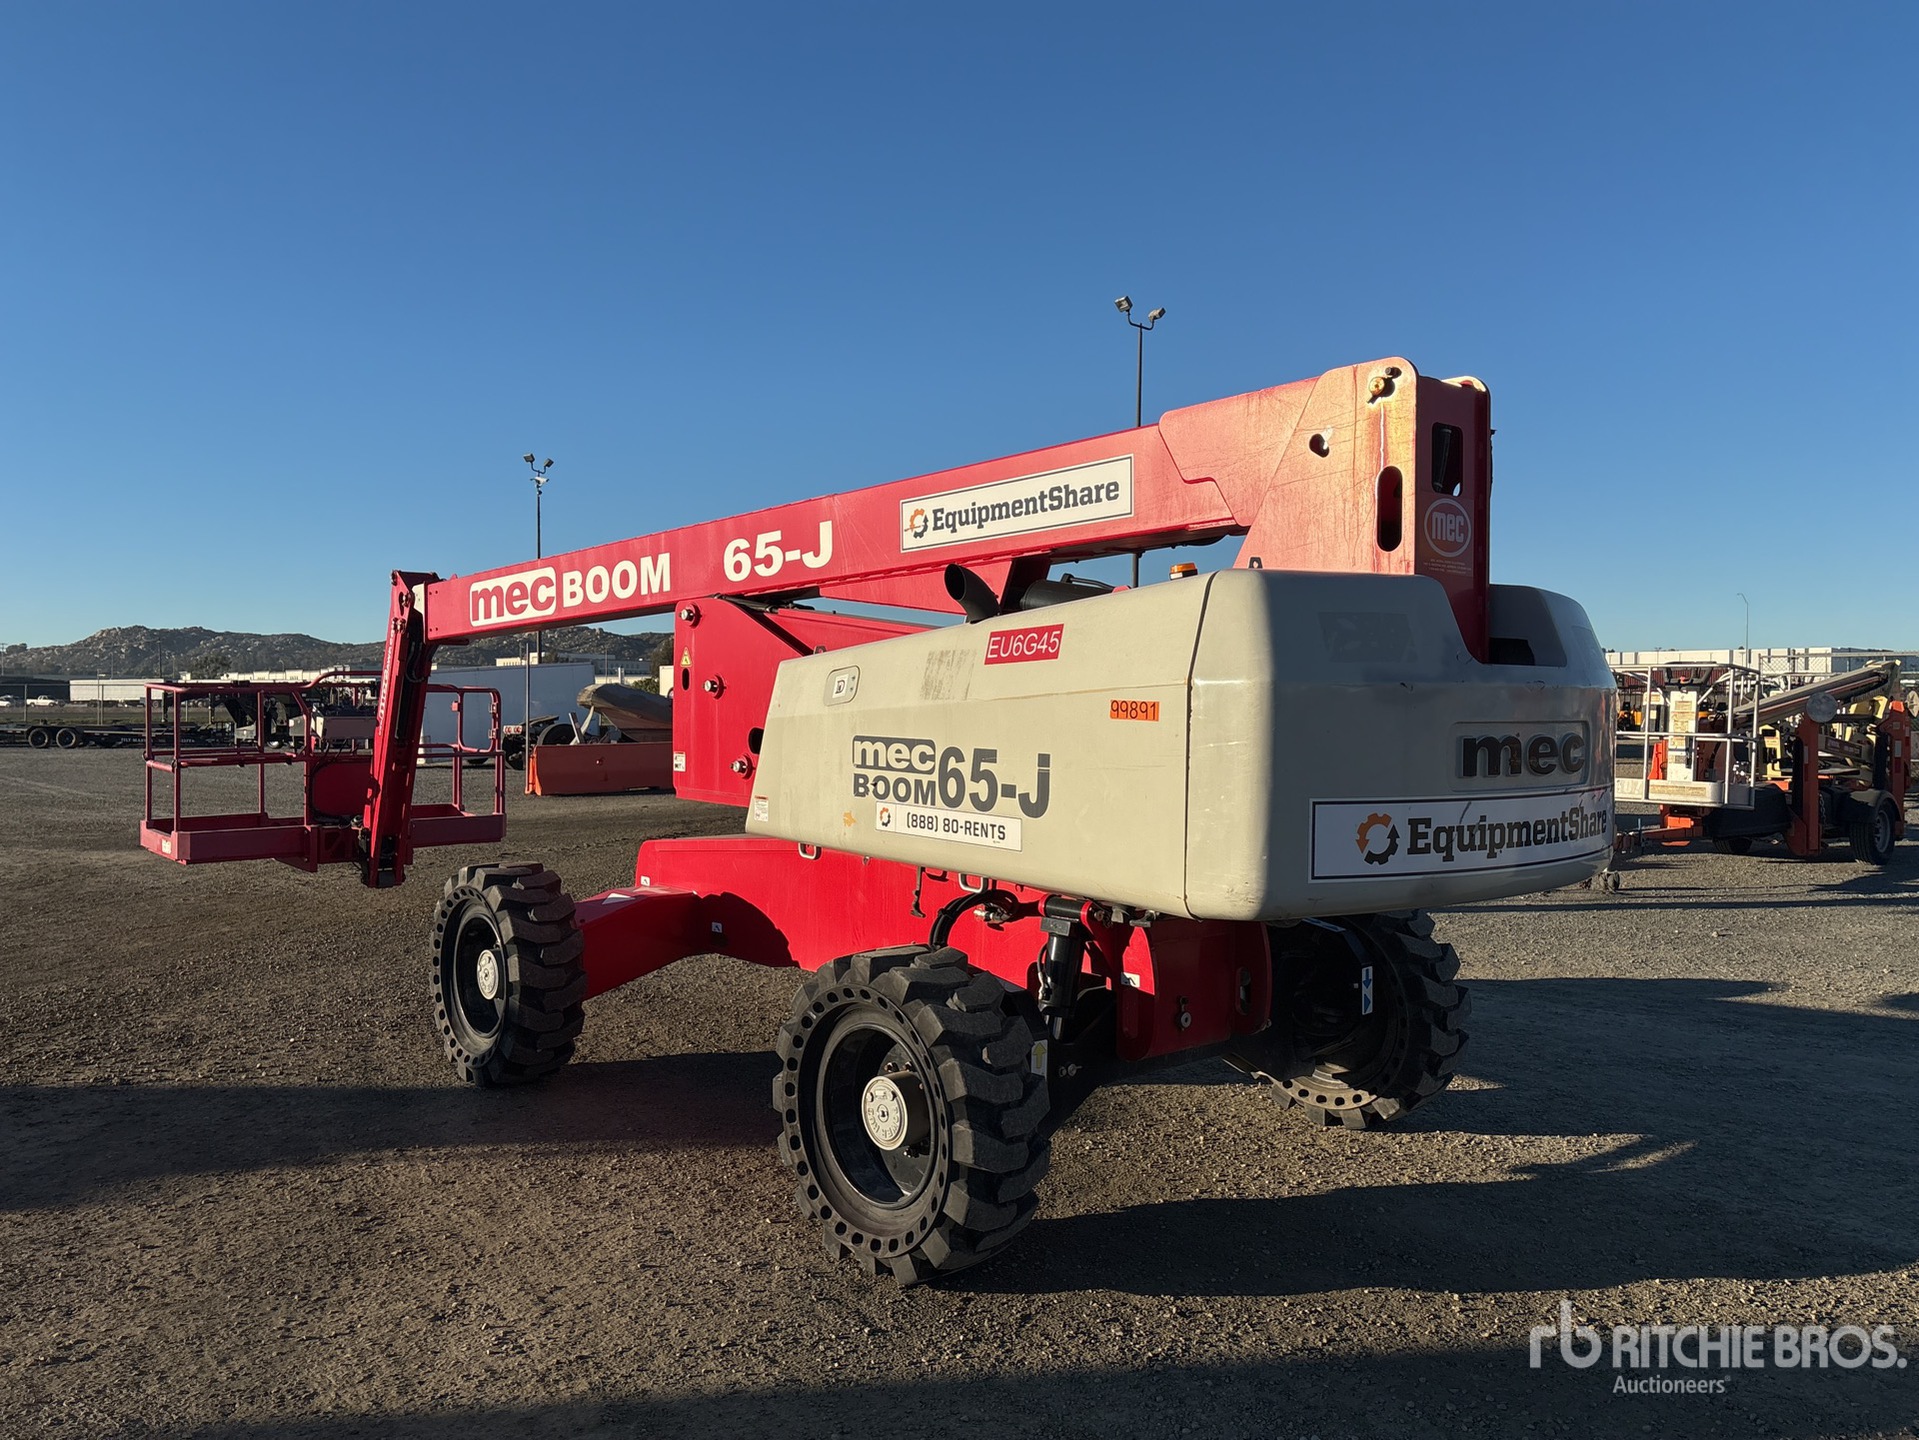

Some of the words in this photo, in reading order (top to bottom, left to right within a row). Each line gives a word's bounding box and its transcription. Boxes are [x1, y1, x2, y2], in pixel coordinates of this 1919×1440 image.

[931, 480, 1120, 534] EquipmentShare
[1431, 511, 1465, 543] mec
[723, 520, 833, 582] 65-J
[471, 575, 556, 622] mec
[562, 552, 671, 609] BOOM
[988, 629, 1061, 660] EU6G45
[1110, 700, 1157, 720] 99891
[853, 739, 935, 774] mec
[1461, 733, 1586, 777] mec
[853, 773, 936, 807] BOOM
[937, 746, 1052, 819] 65-J
[906, 811, 939, 833] (888)
[943, 817, 1006, 841] 80-RENTS
[1407, 804, 1609, 862] EquipmentShare
